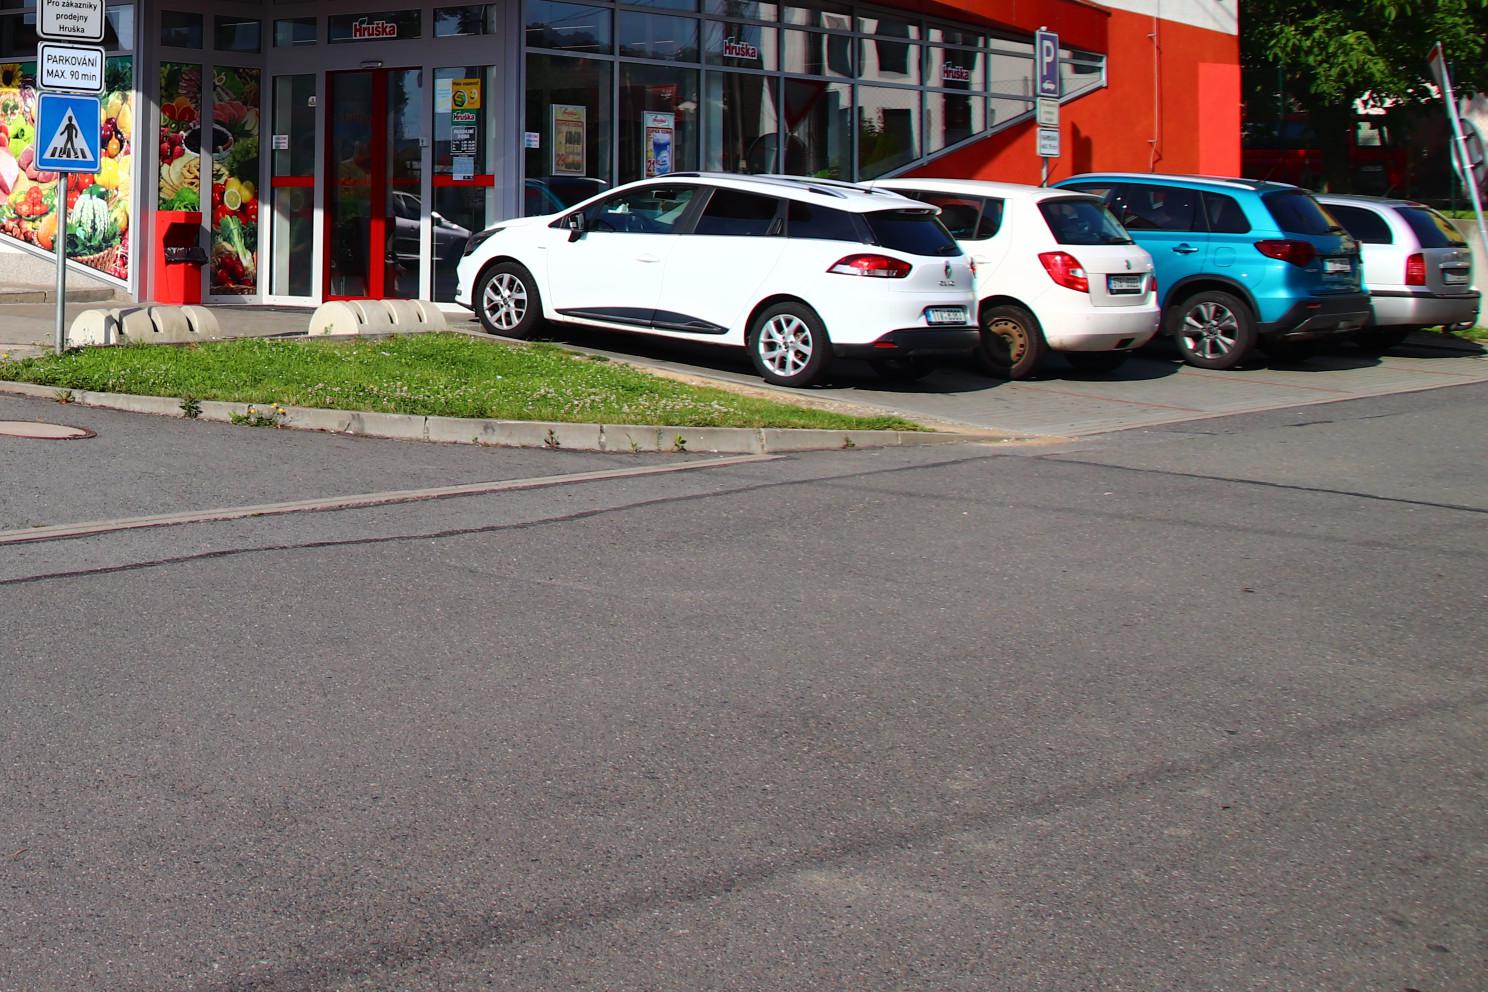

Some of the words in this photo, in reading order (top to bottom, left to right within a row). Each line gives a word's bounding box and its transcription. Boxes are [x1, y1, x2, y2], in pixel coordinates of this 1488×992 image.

[47, 0, 60, 7] Pro
[56, 12, 89, 23] prodejny
[59, 24, 85, 33] Hruška
[354, 21, 396, 37] Hruška
[724, 40, 756, 58] Hruška
[47, 54, 98, 67] PARKOVÁNÍ
[1042, 40, 1055, 76] P
[70, 70, 80, 80] 90
[81, 72, 97, 81] min
